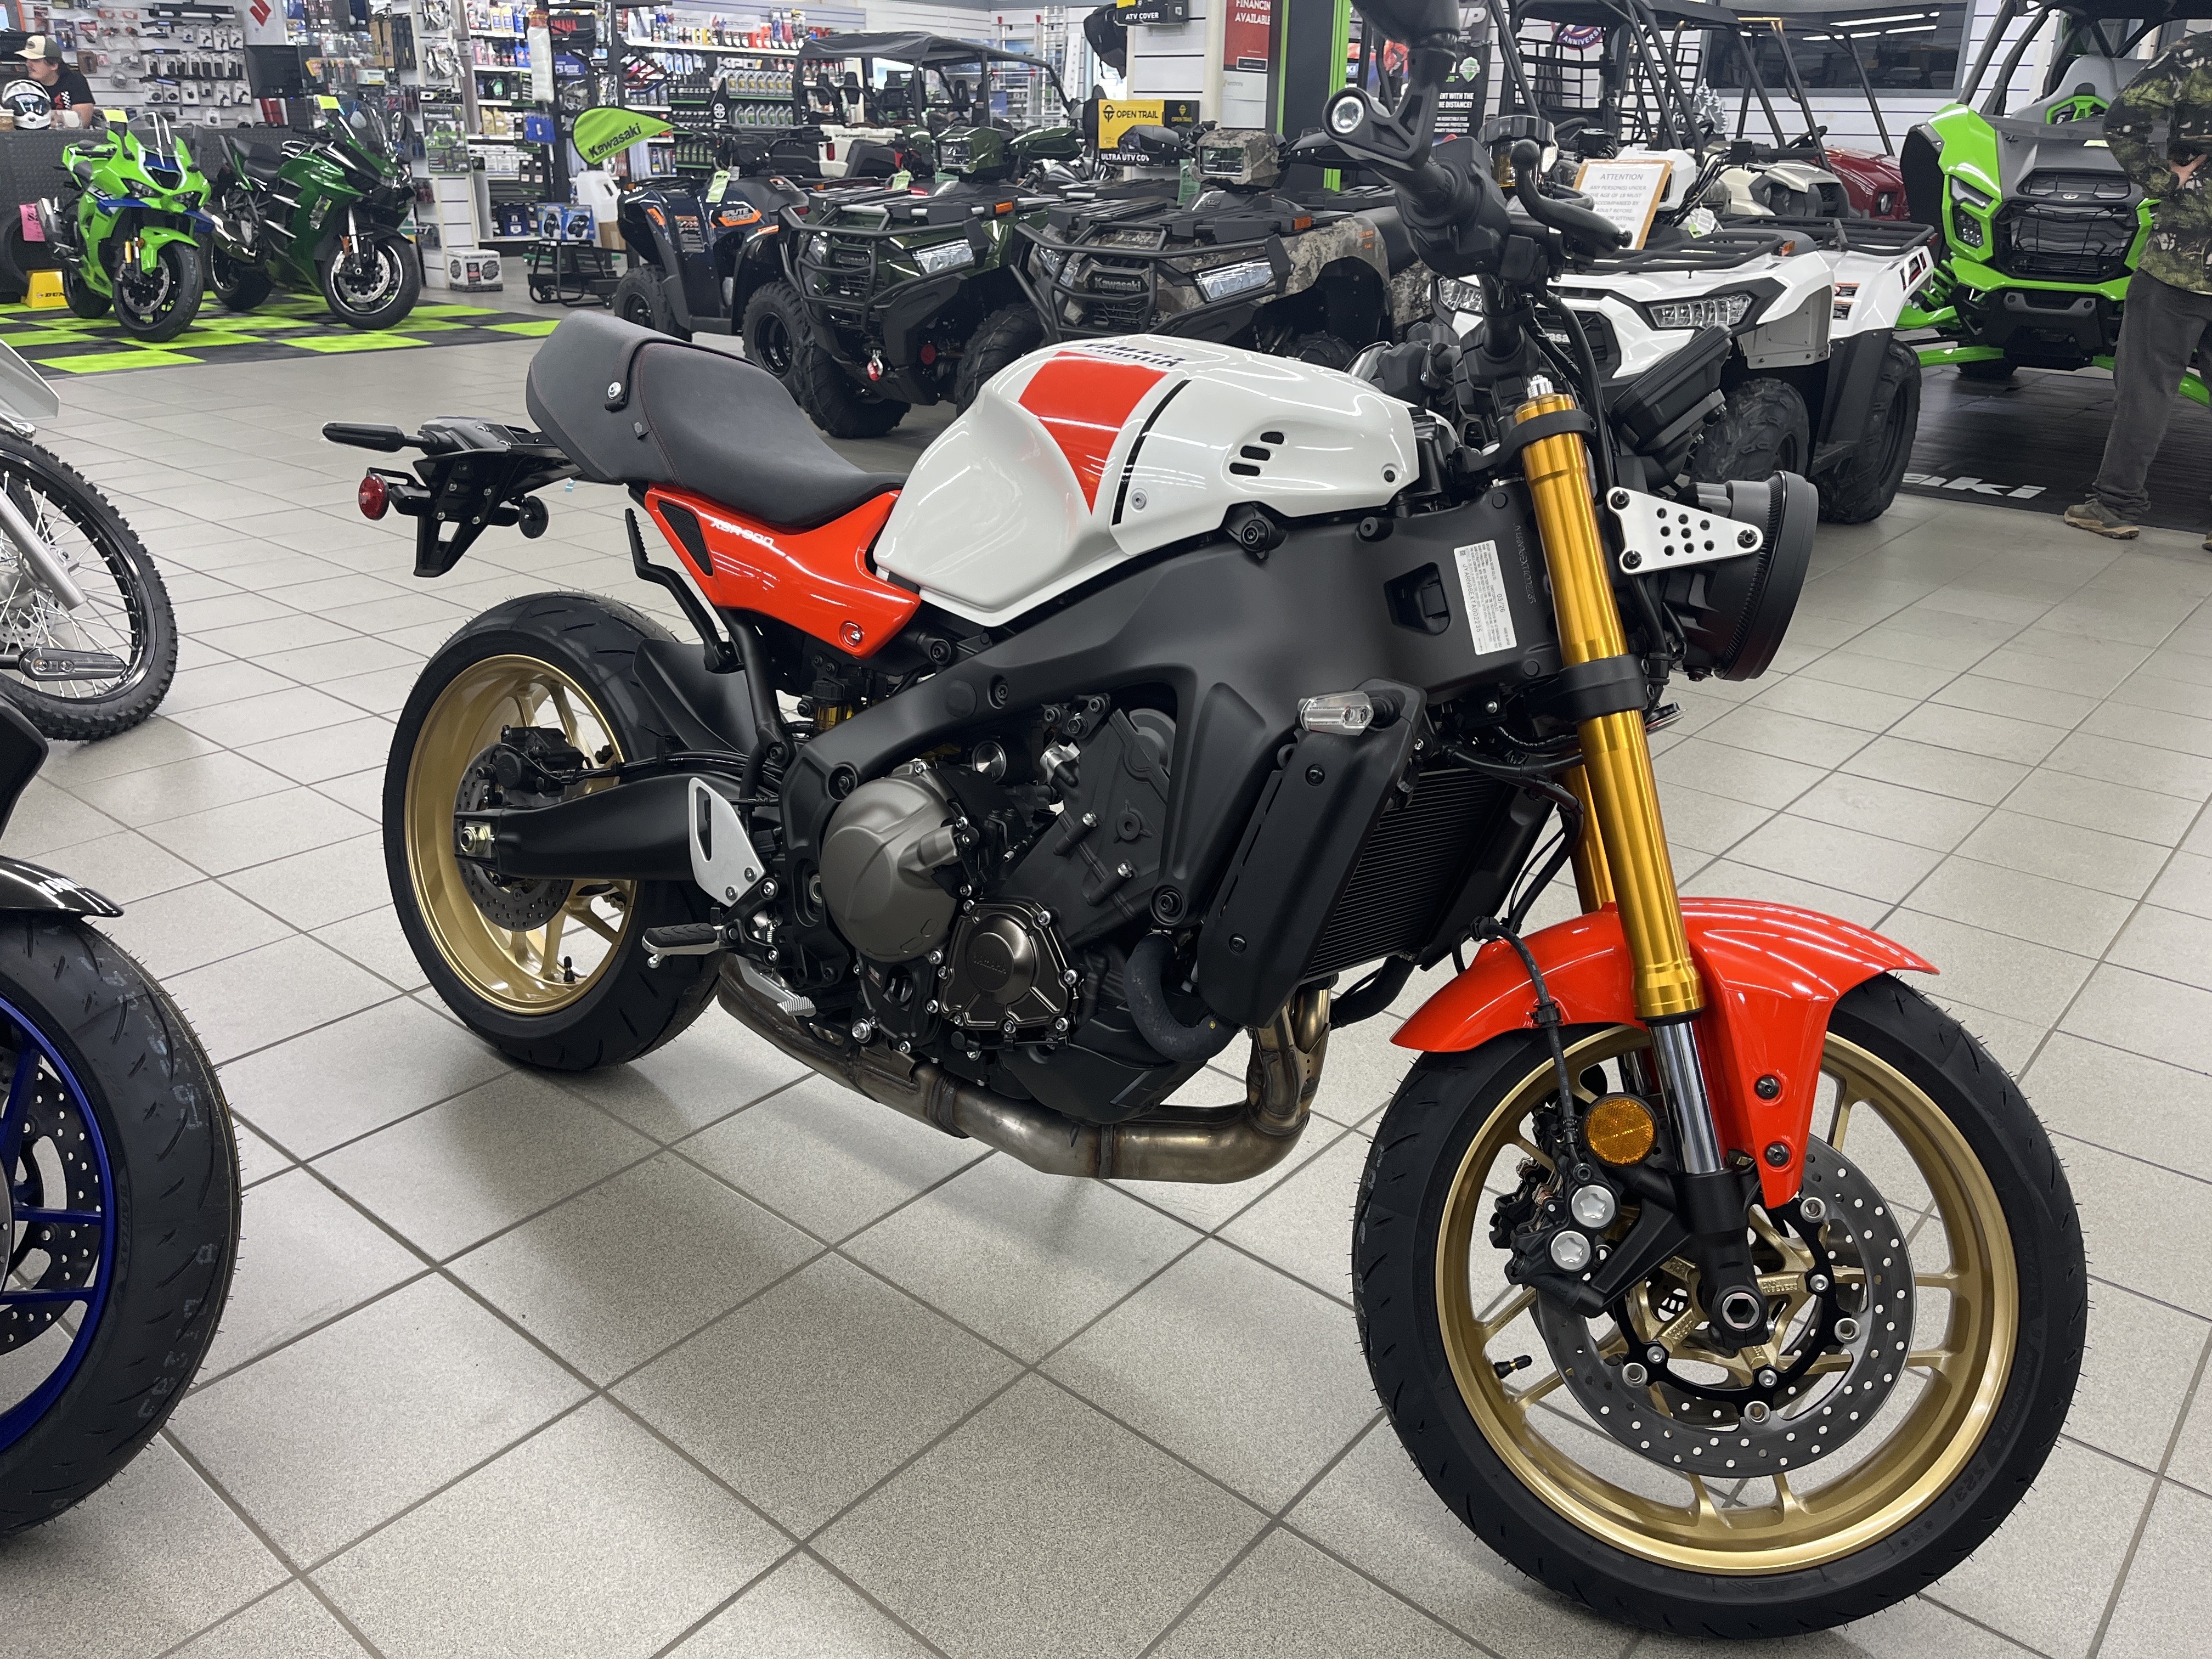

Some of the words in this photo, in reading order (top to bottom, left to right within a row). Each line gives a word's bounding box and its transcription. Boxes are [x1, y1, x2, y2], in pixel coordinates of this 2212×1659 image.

[1235, 0, 1271, 10] FINANCIN
[1235, 12, 1271, 25] AVAILABLE
[1116, 110, 1136, 119] OPEN
[1138, 110, 1159, 119] TRAIL
[589, 122, 641, 159] Kawasaki
[721, 207, 749, 217] BRUTE
[727, 213, 753, 222] FORCE
[1094, 277, 1141, 292] Kawasaki
[1497, 593, 1506, 613] 03/26
